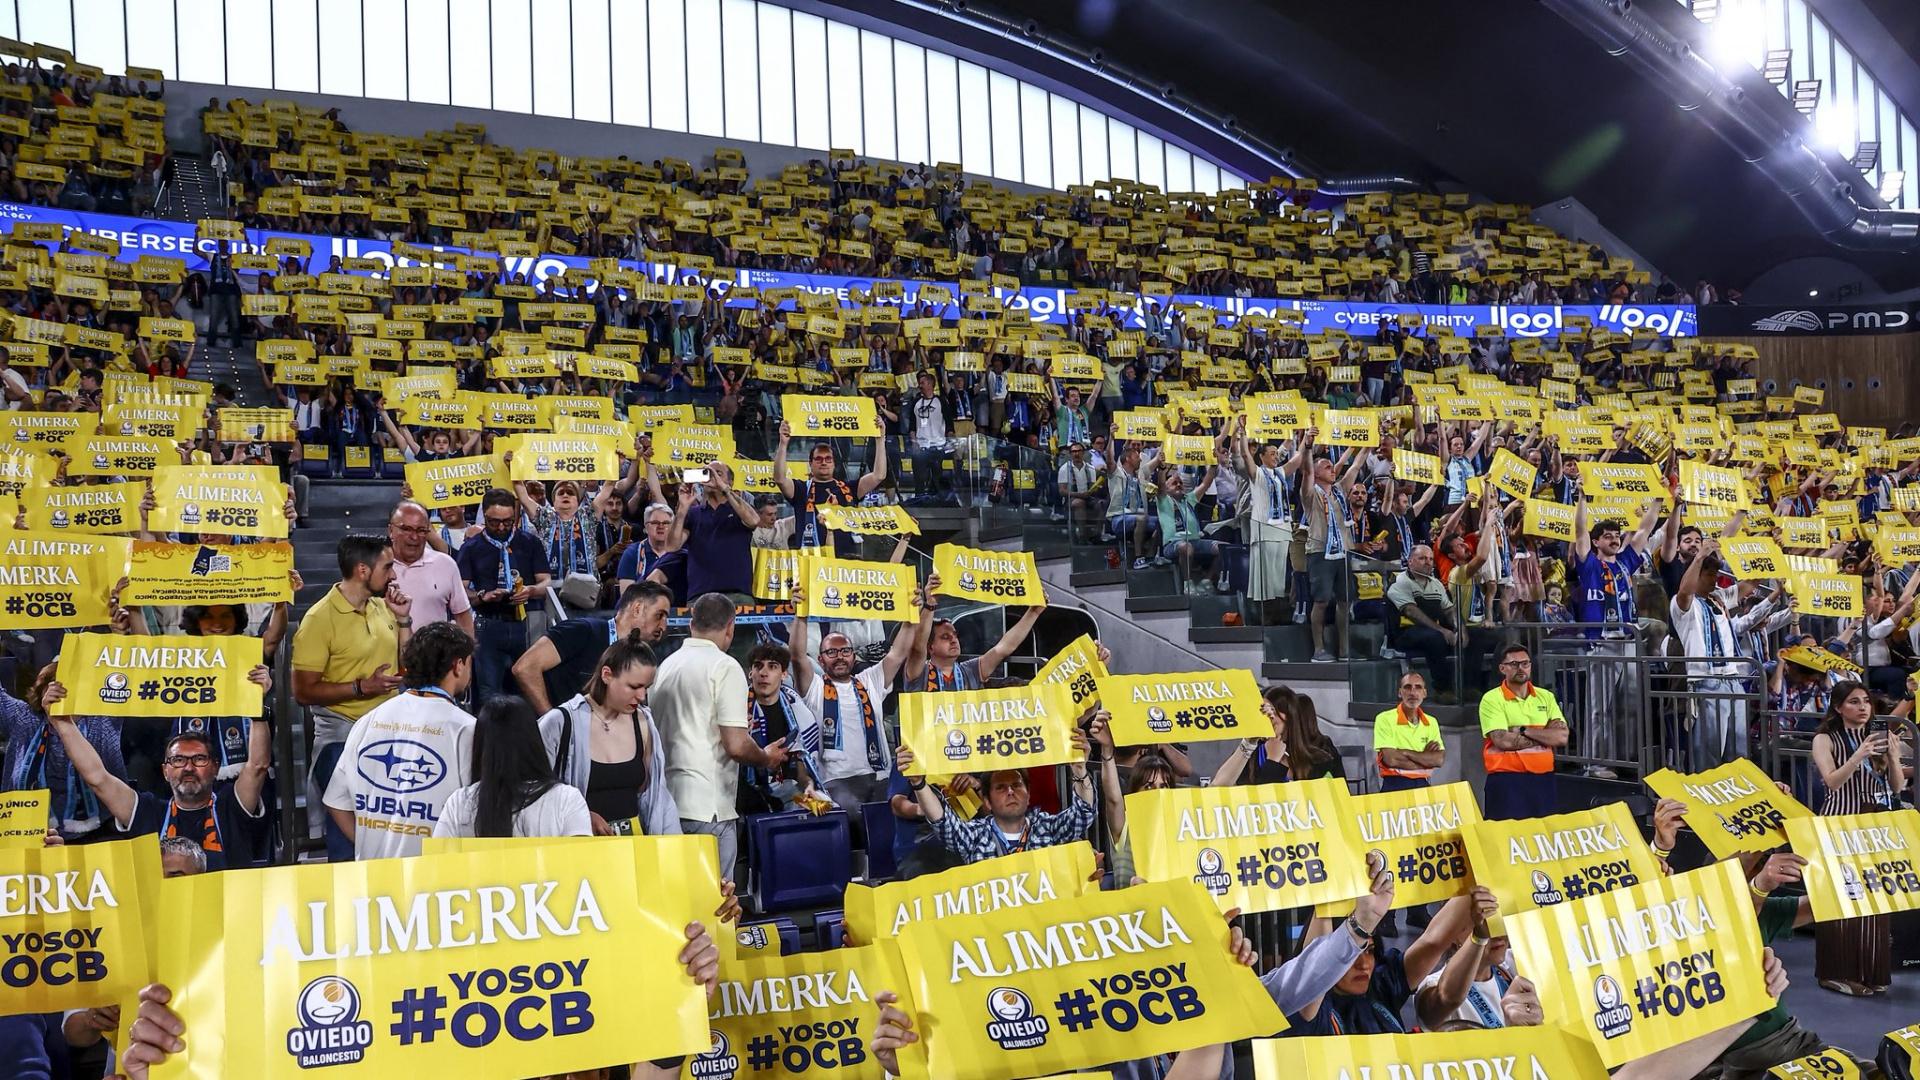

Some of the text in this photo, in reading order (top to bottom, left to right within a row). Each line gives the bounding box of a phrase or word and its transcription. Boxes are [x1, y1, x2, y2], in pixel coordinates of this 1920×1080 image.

[395, 379, 442, 390] ALIMERKA
[418, 401, 468, 412] ALIMERKA
[490, 402, 539, 412] ALIMERKA
[554, 400, 601, 408] ALIMERKA
[800, 400, 860, 413] ALIMERKA
[1257, 402, 1296, 412] ALIMERKA
[1446, 398, 1487, 408] ALIMERKA
[1500, 400, 1532, 408] ALIMERKA
[118, 410, 180, 421] ALIMERKA
[640, 410, 682, 418] ALIMERKA
[1330, 415, 1371, 426] ALIMERKA
[9, 416, 80, 427] ALIMERKA
[568, 422, 622, 436] ALIMERKA
[677, 427, 720, 438] ALIMERKA
[1567, 427, 1602, 436] ALIMERKA
[34, 432, 64, 442] #OC
[87, 441, 160, 453] ALIMERKA
[529, 440, 600, 453] ALIMERKA
[668, 438, 723, 451] ALIMERKA
[424, 462, 496, 482] ALIMERKA
[739, 464, 792, 478] ALIMEA
[1592, 468, 1646, 478] ALIMERKA
[46, 490, 126, 507] ALIMERKA
[176, 484, 264, 503] ALIMERKA
[836, 510, 896, 519] ALIMERKA
[954, 554, 1029, 574] ALIMERKA
[817, 568, 898, 587] ALIMERKA
[94, 646, 226, 669] ALIMERKA
[100, 690, 131, 699] OVIEDO
[1132, 682, 1233, 704] ALIMERKA
[934, 698, 1047, 726] ALIMERKA
[945, 746, 970, 755] OVIEDO
[6, 800, 39, 808] ÚNICO
[1177, 800, 1325, 841] ALIMERKA
[24, 828, 45, 836] 25/26
[1510, 823, 1629, 865] ALIMERKA
[1534, 892, 1561, 904] OVIEDO
[259, 878, 609, 965] ALIMERKA
[1567, 895, 1716, 972] ALIMERKA
[950, 906, 1192, 984] ALIMERKA
[709, 969, 869, 1019] IMERKA
[1596, 1006, 1631, 1029] OVIEDO
[988, 1019, 1047, 1041] OVIEDO
[290, 1023, 371, 1051] OVIEDO
[1002, 1037, 1044, 1050] BALONCESTO
[302, 1050, 361, 1066] BALONCESTO
[692, 1057, 738, 1075] OVIEDO
